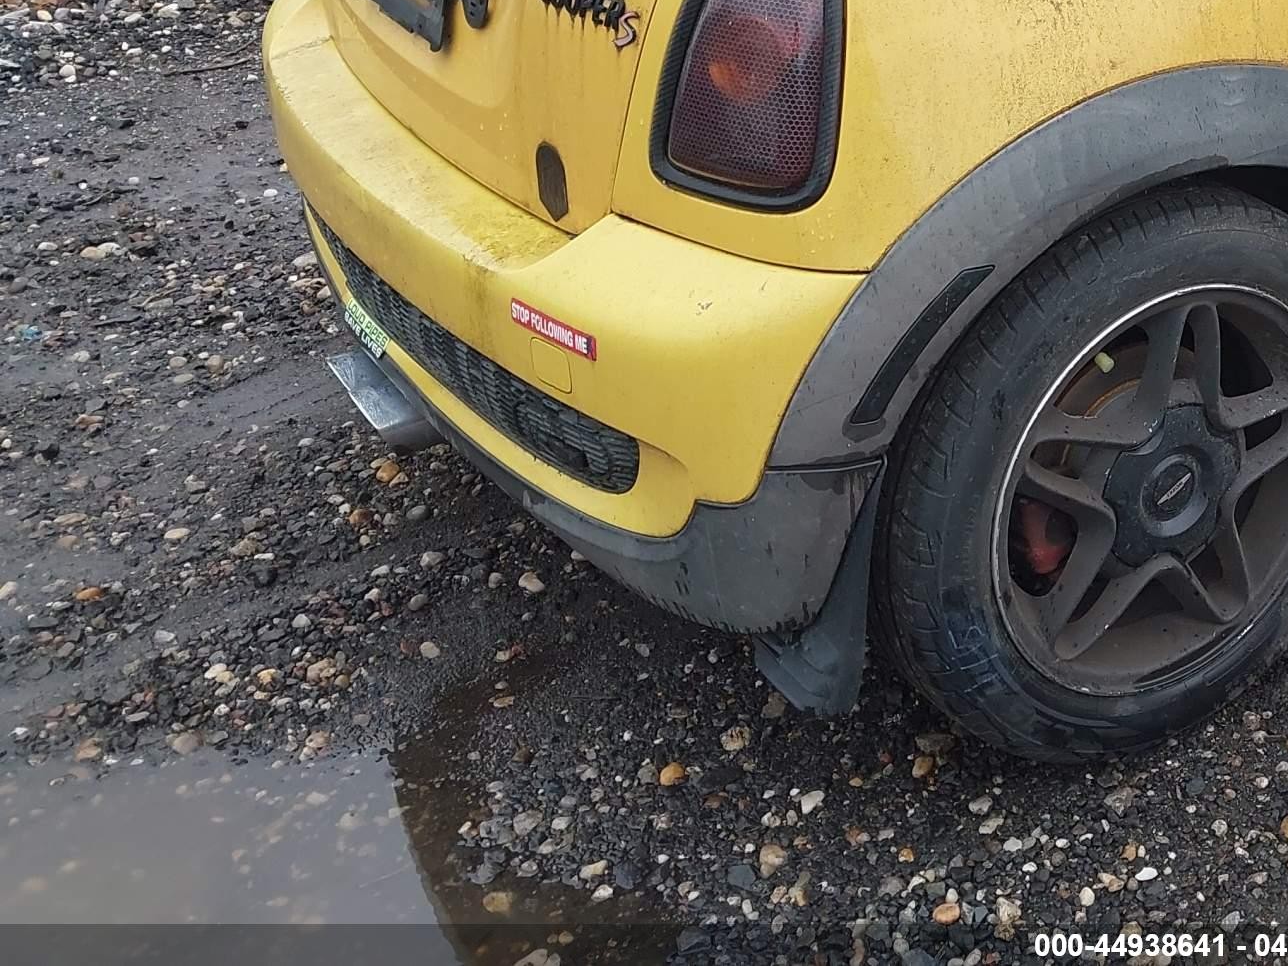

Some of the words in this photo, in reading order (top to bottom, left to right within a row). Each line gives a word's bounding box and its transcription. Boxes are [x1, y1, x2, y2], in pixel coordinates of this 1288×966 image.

[612, 10, 640, 48] S
[348, 299, 366, 324] LOUD
[365, 320, 388, 348] PIPES
[361, 331, 383, 359] LIVES
[511, 302, 530, 324] STOP
[530, 312, 574, 348] FOLLOWING
[574, 334, 588, 354] ME
